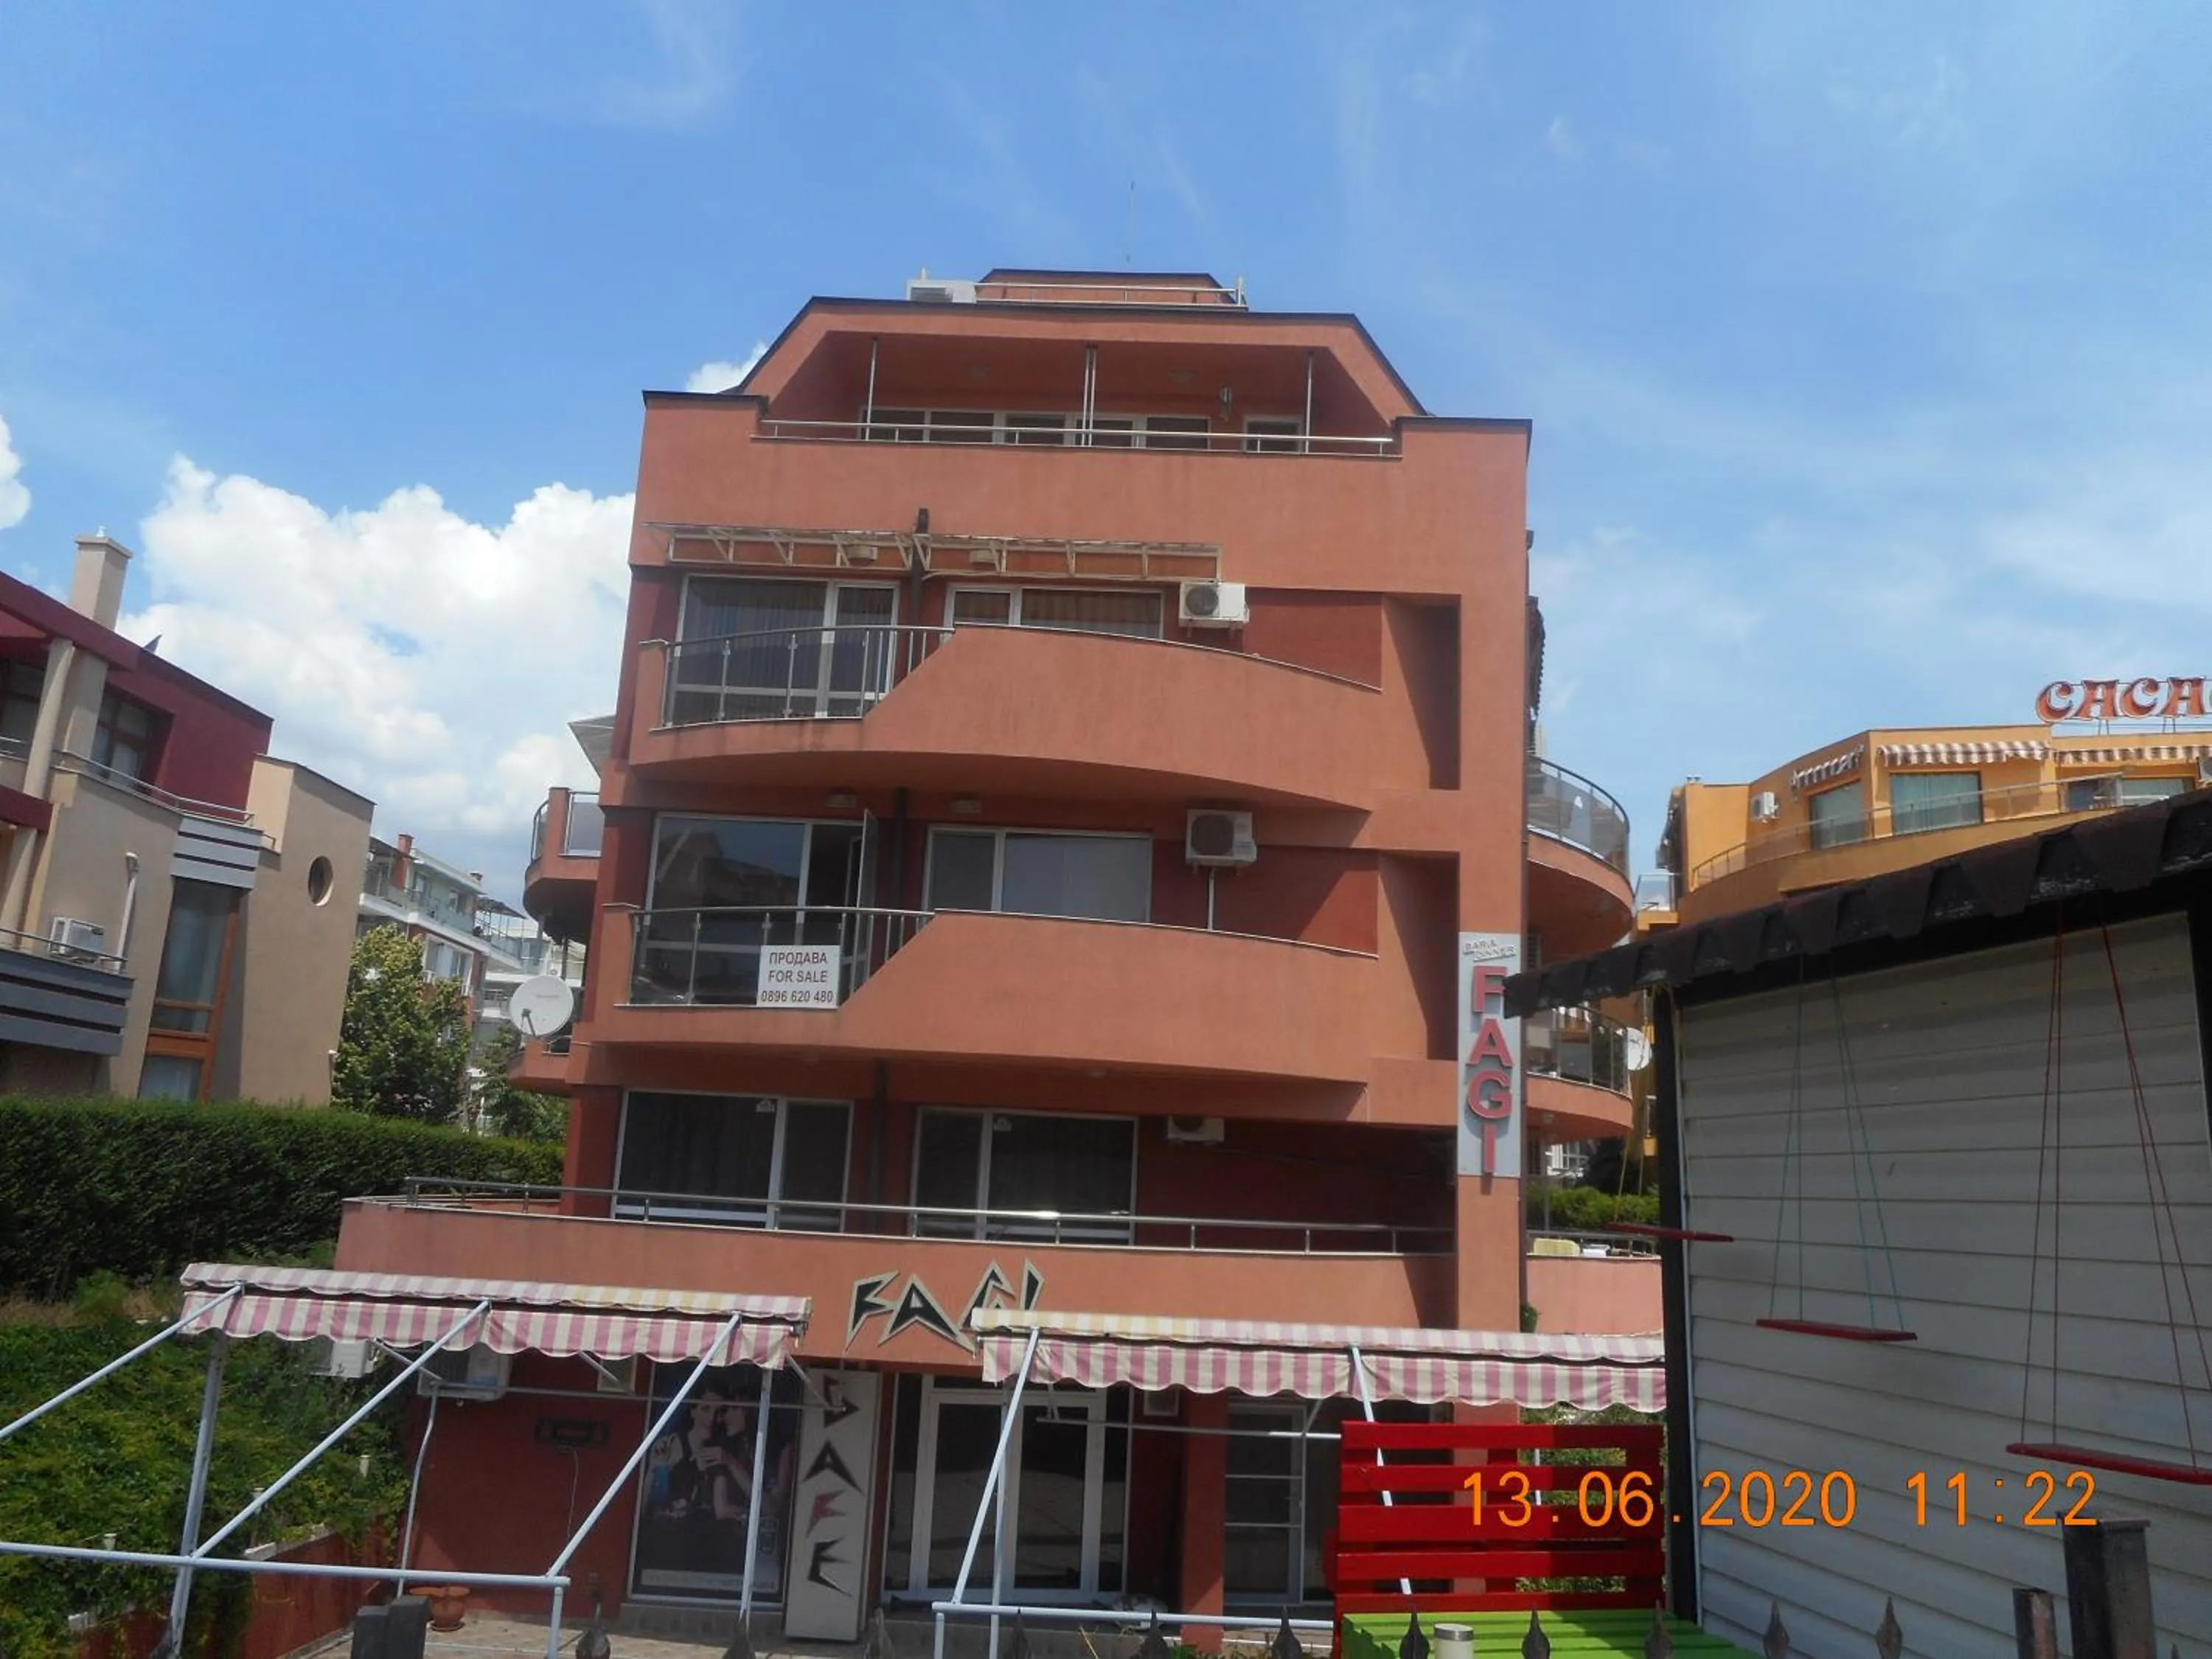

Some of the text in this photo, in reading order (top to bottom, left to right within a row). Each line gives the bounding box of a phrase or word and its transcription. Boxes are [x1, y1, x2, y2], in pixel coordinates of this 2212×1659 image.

[2036, 676, 2212, 724] CACA
[769, 952, 827, 965] ПРОДАВА
[768, 970, 827, 982] FOR SALE
[761, 990, 833, 1002] 0896 620 480
[1467, 966, 1514, 1173] FAGI
